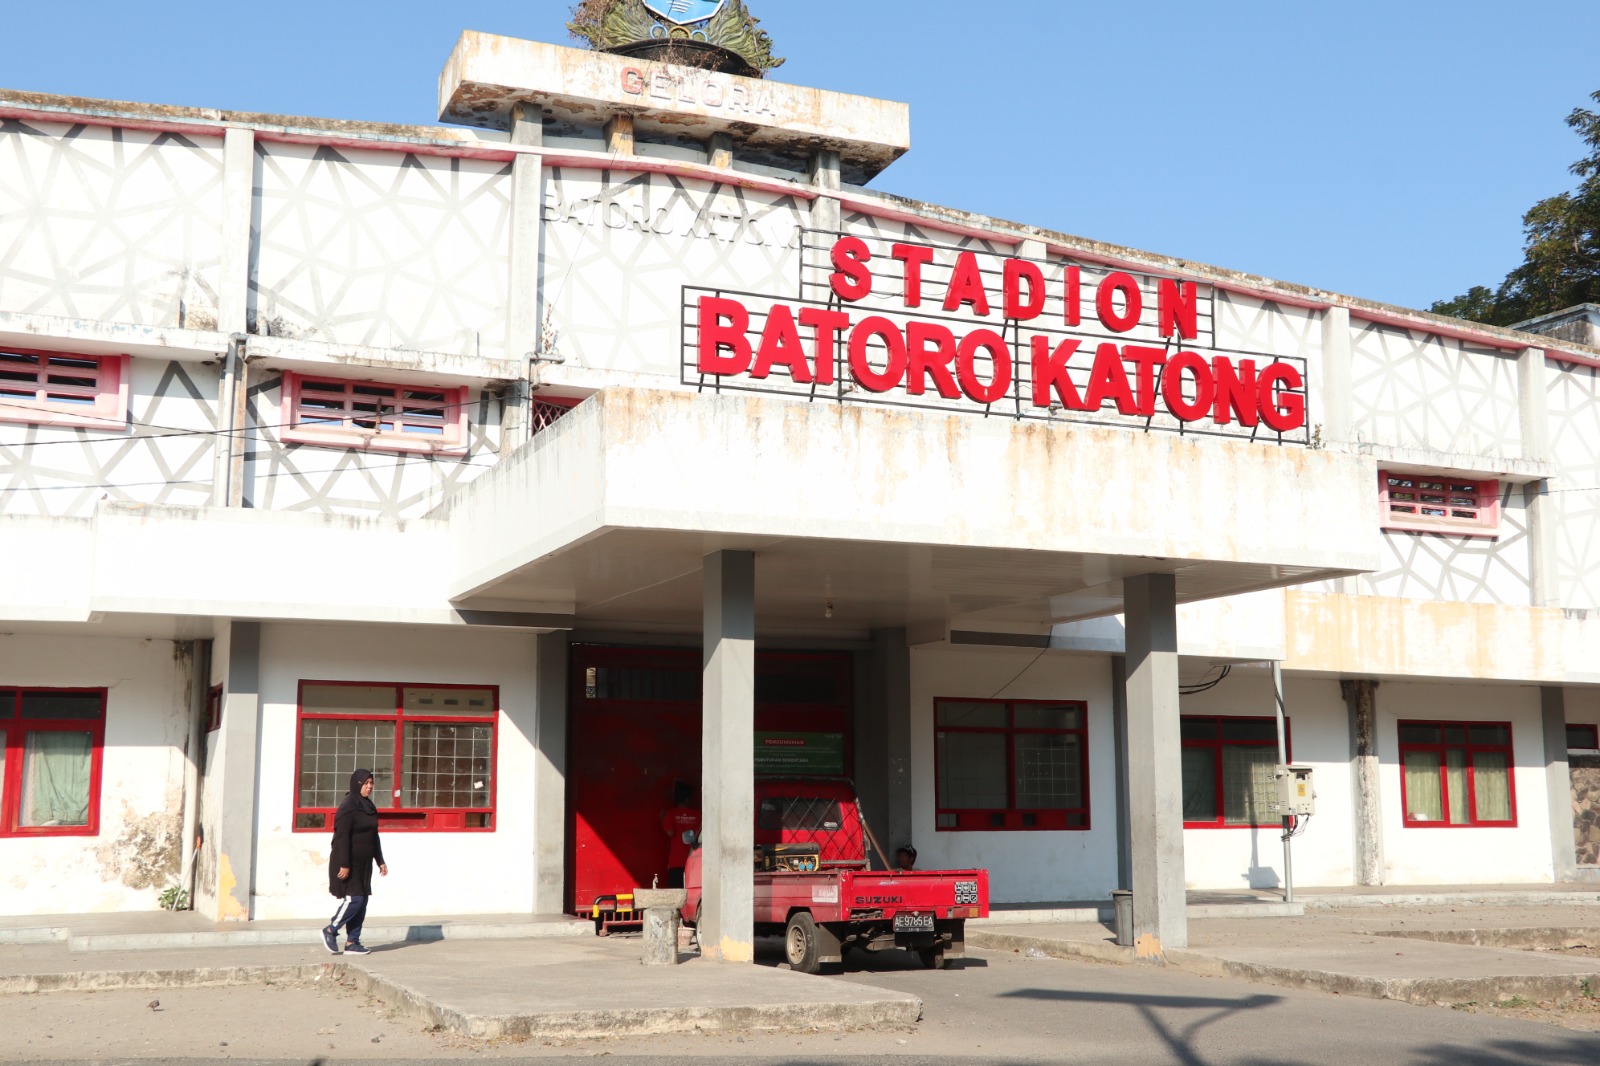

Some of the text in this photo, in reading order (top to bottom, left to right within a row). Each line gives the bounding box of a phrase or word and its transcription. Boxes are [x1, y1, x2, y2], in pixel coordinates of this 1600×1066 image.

[620, 67, 776, 117] GELORA
[829, 235, 1198, 341] STADION
[696, 295, 1306, 433] BATORO KATONG
[855, 895, 903, 905] SUZUKI
[895, 916, 904, 927] AE
